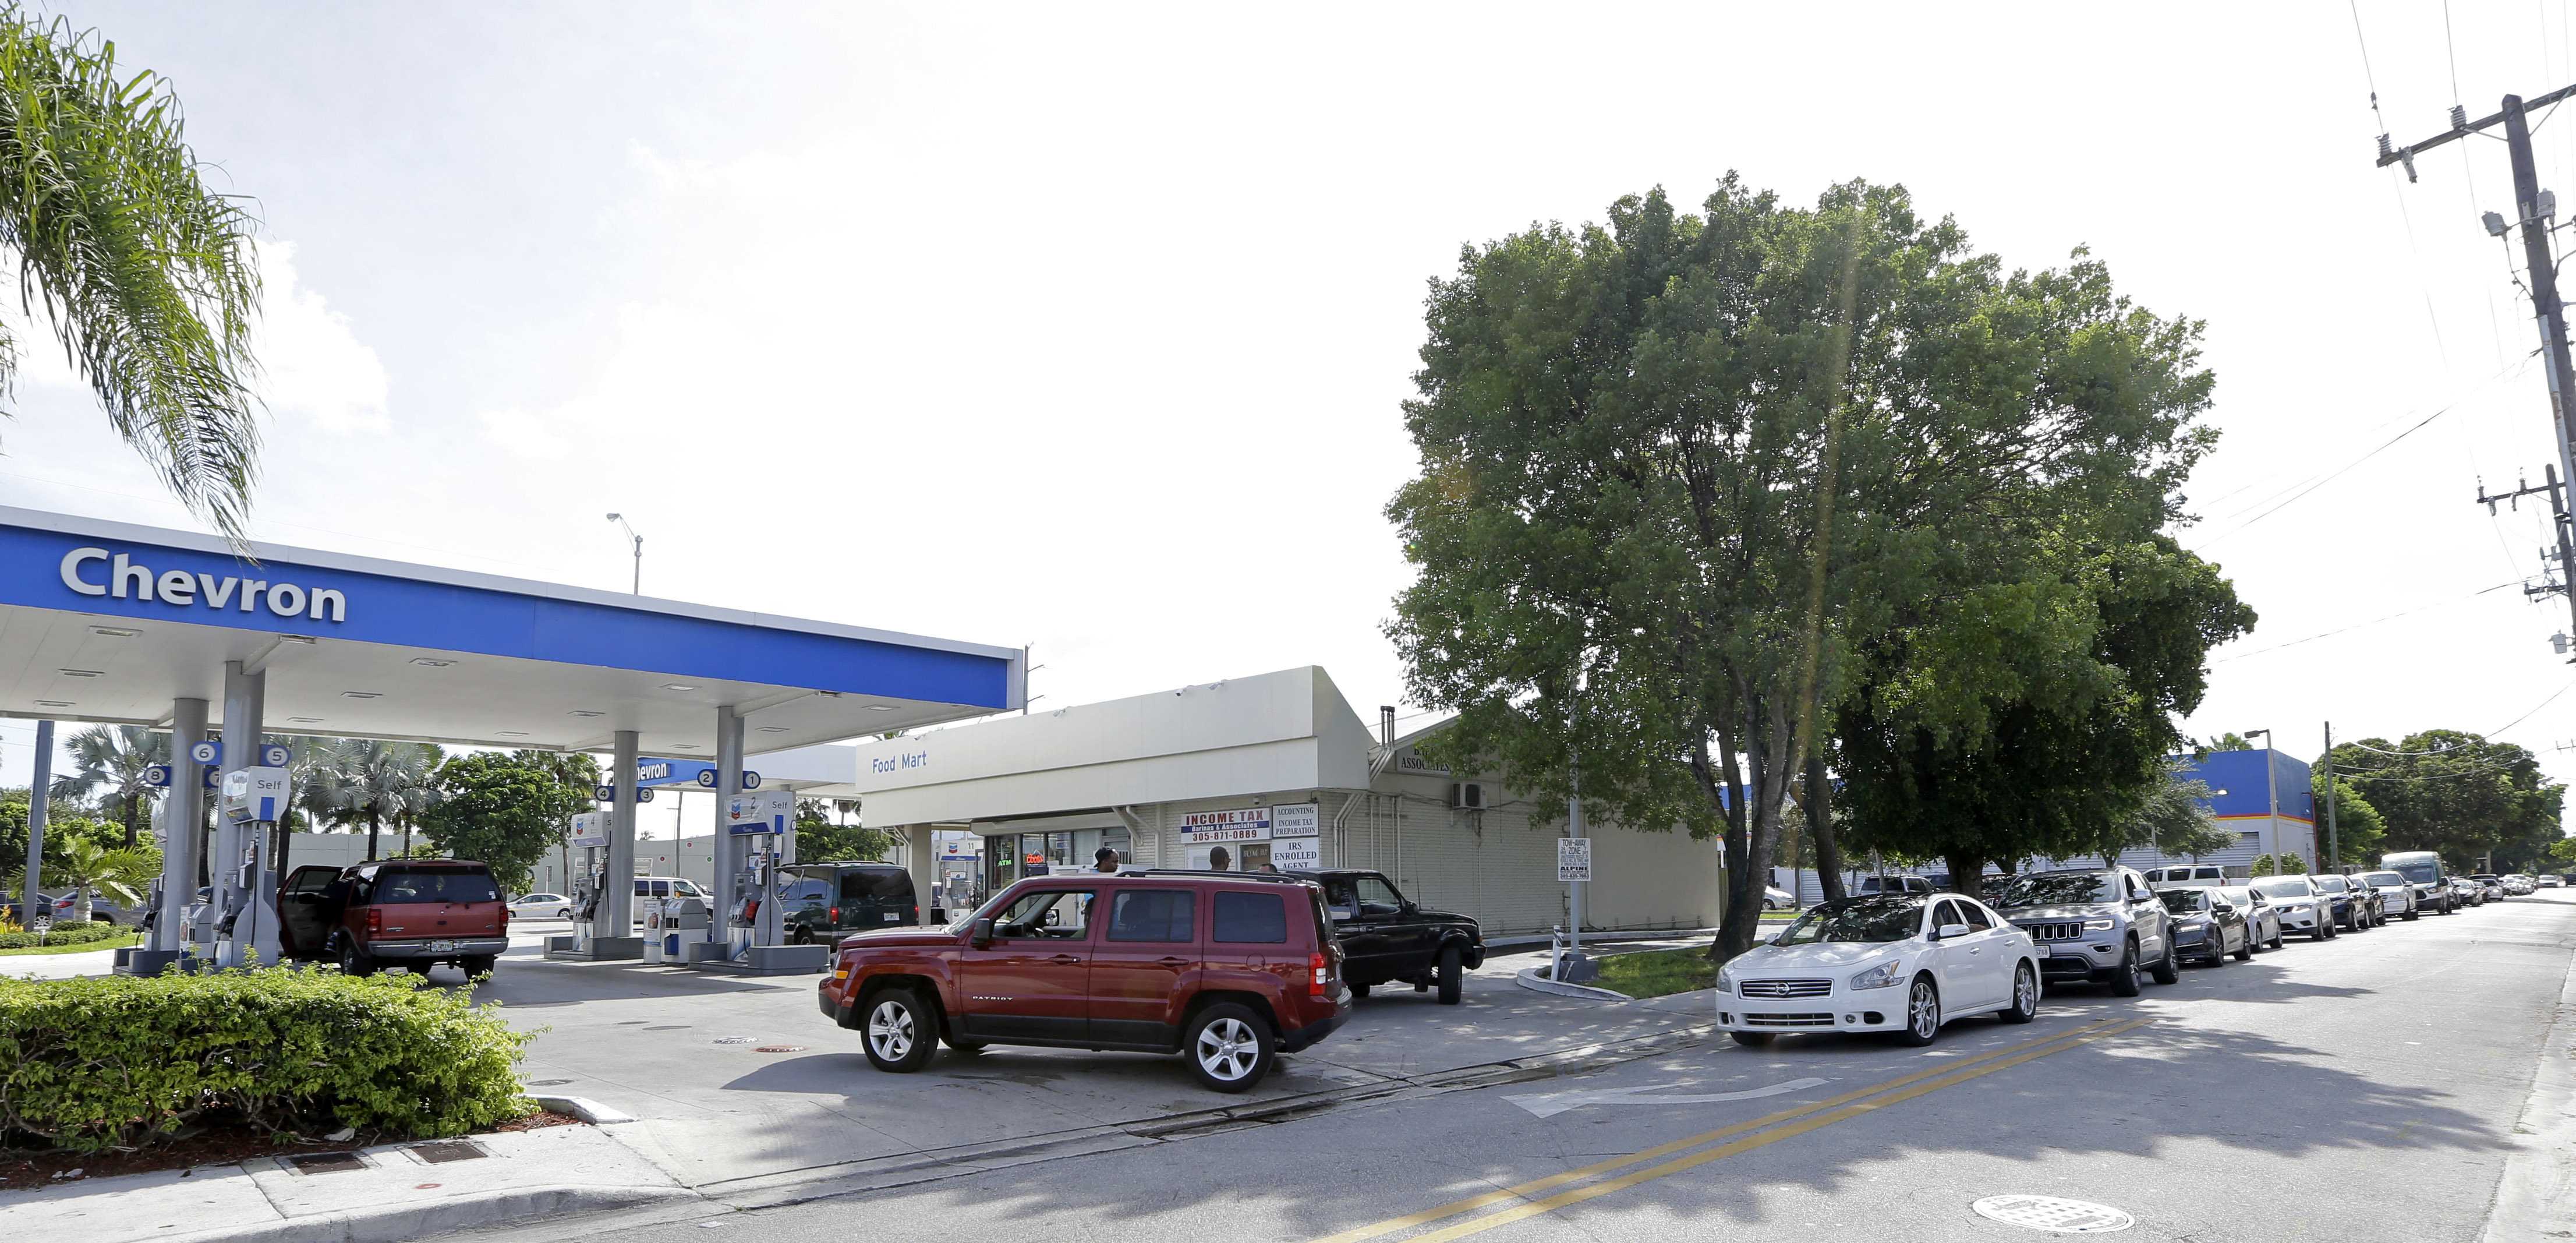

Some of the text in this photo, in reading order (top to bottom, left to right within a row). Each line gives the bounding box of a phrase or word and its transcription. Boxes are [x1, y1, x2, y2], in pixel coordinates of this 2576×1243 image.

[60, 547, 346, 622] Chevron
[199, 748, 209, 758] 6
[273, 751, 282, 761] 5
[873, 750, 926, 774] Food Mart
[151, 771, 160, 780] 8
[703, 774, 710, 782] 2
[257, 780, 282, 790] Self
[643, 791, 649, 799] 3
[750, 796, 756, 810] 2
[772, 801, 788, 809] Self
[1277, 807, 1314, 815] ACCOUNTING
[1186, 810, 1264, 825] INCOME TAX
[1193, 829, 1257, 841] 305-871-0889
[1276, 827, 1315, 835] PREPARATION
[1562, 839, 1587, 847] TOW-AWAY
[1275, 850, 1317, 861] ENROLLED
